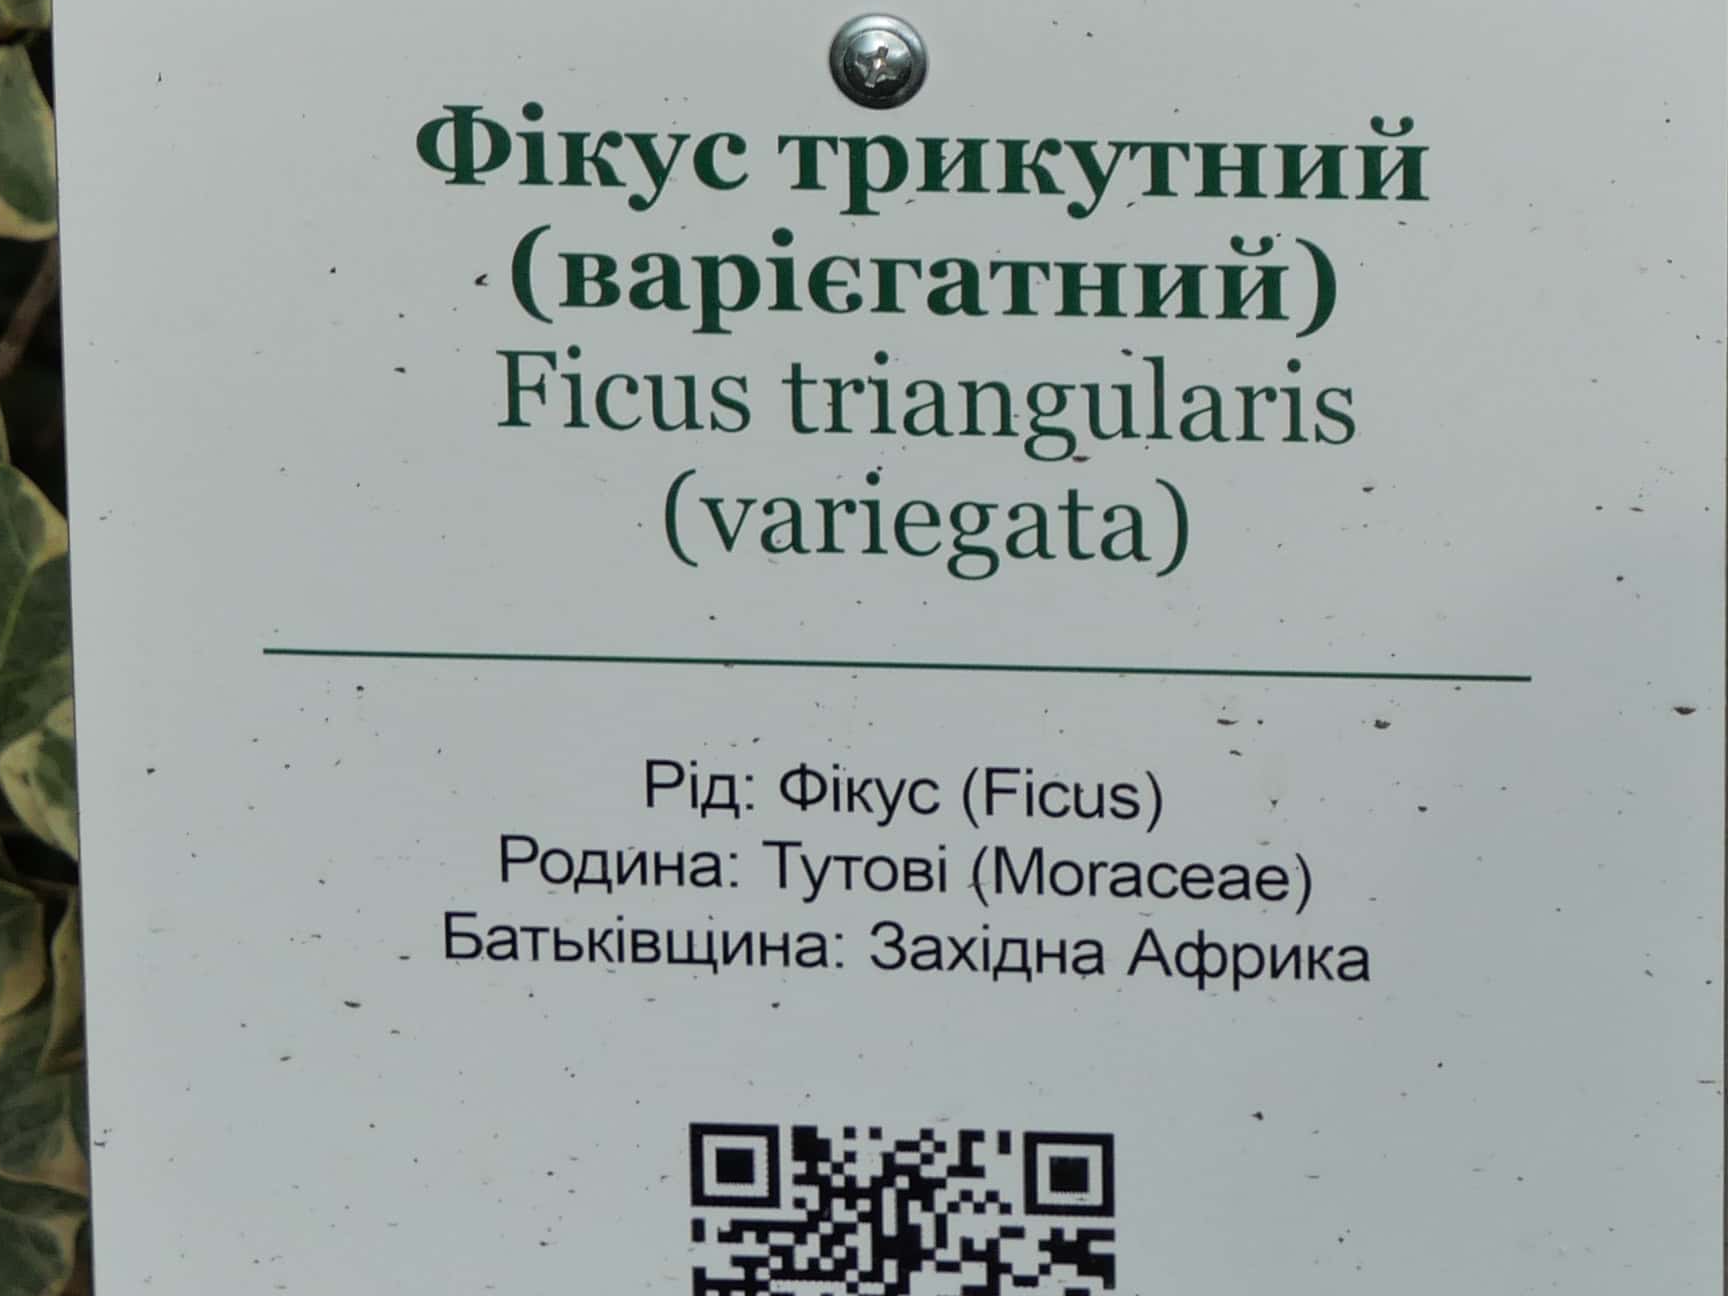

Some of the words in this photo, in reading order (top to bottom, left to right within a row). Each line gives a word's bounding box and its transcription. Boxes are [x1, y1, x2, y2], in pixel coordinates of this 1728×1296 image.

[415, 100, 750, 213] Фікус
[777, 115, 1430, 219] трикутний
[511, 224, 1338, 339] (варієгатний)
[495, 344, 752, 434] Ficus
[783, 351, 1357, 462] triangularis
[664, 468, 1190, 583] (variegata)
[644, 758, 755, 820] Рід:
[778, 761, 941, 828] Фікус
[962, 766, 1164, 834] (Ficus)
[498, 833, 740, 895] Родина:
[761, 839, 948, 906] Тутові
[970, 845, 1313, 916] (Moraceae)
[442, 910, 845, 976] Батьківщина:
[869, 919, 1106, 984] Західна
[1126, 927, 1371, 993] Африка
